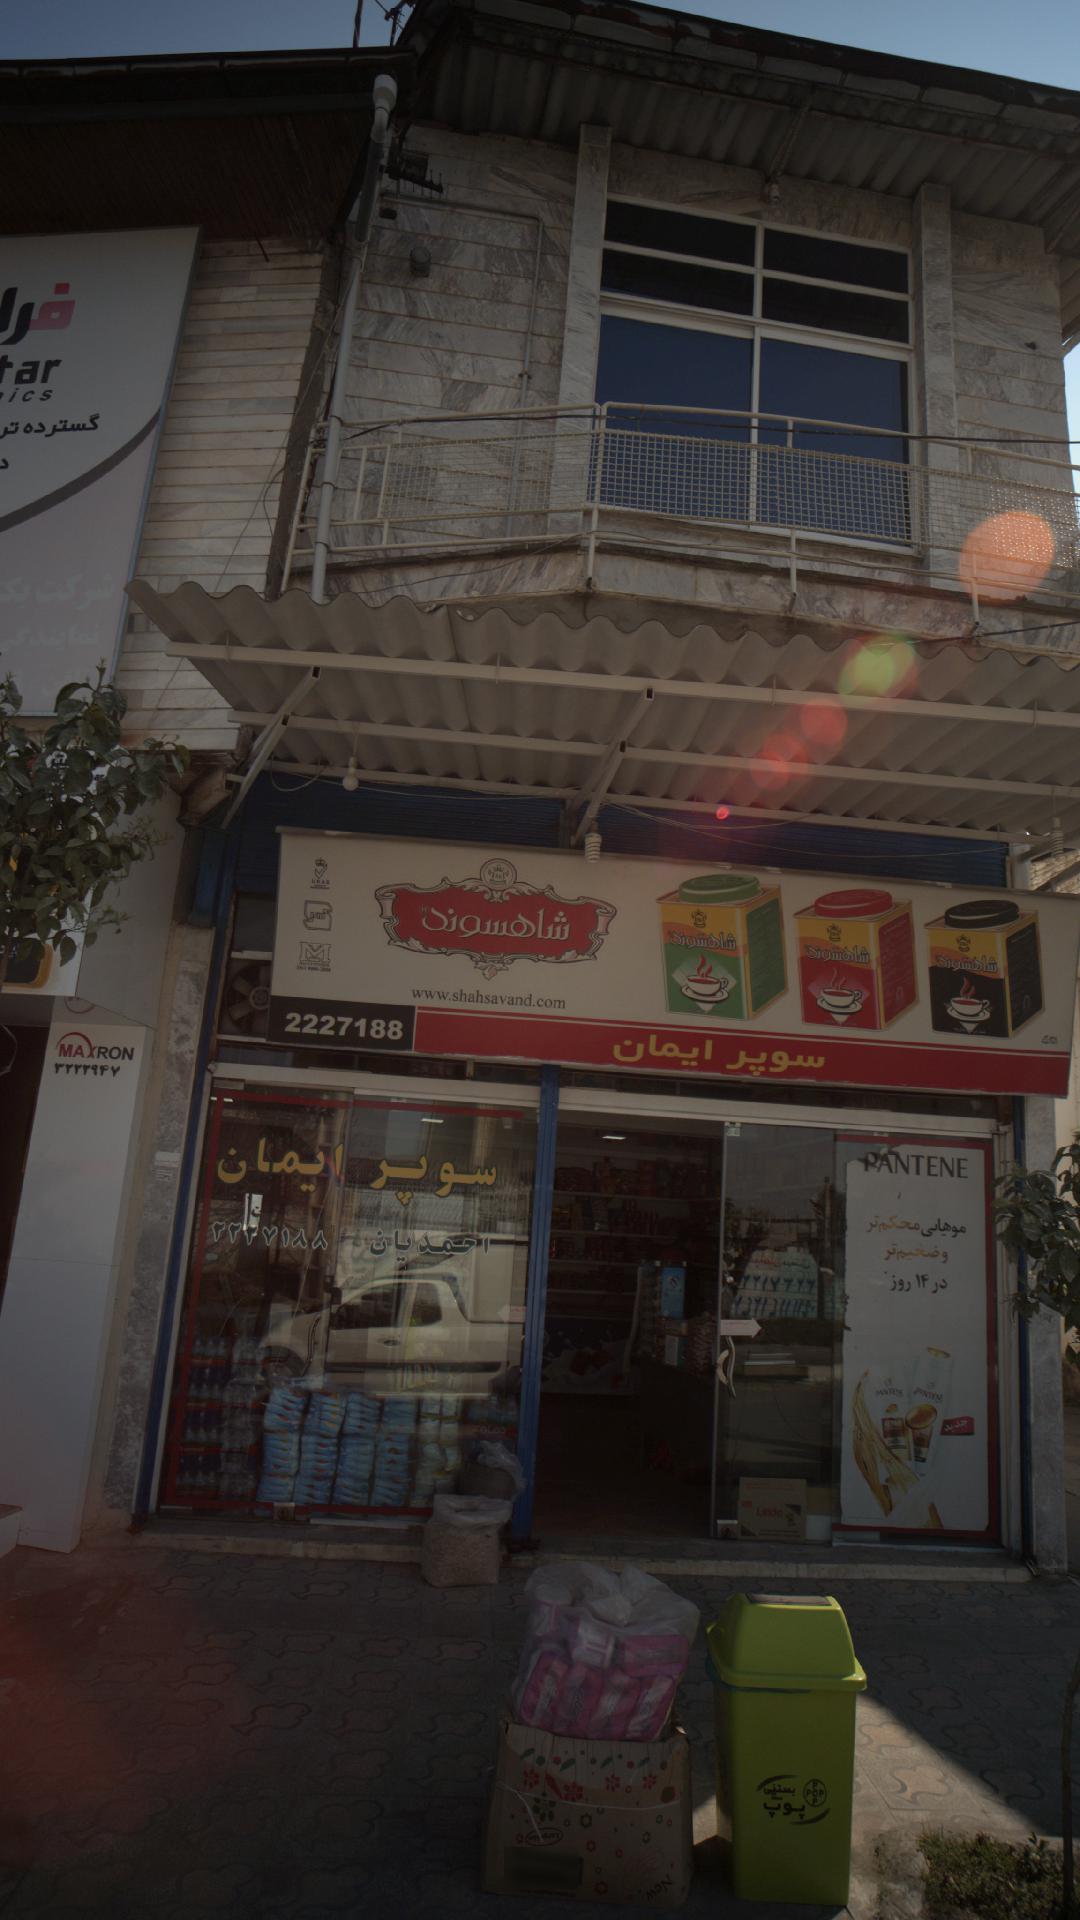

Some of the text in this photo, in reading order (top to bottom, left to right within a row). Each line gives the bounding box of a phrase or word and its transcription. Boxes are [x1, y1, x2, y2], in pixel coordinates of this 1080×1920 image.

[23, 413, 100, 438] گسترده
[421, 907, 571, 942] شاهسوند
[411, 987, 566, 1010] www.shahsavand.com
[284, 1011, 404, 1041] 2227188
[58, 1042, 136, 1061] MAXRON
[612, 1034, 826, 1077] سوپر ایمان
[216, 1136, 497, 1206] سوپر ایمان
[862, 1151, 969, 1179] PANTENE
[370, 1228, 491, 1264] احمدیان
[915, 1272, 930, 1289] ۱۴
[762, 1801, 806, 1820] پوپ
